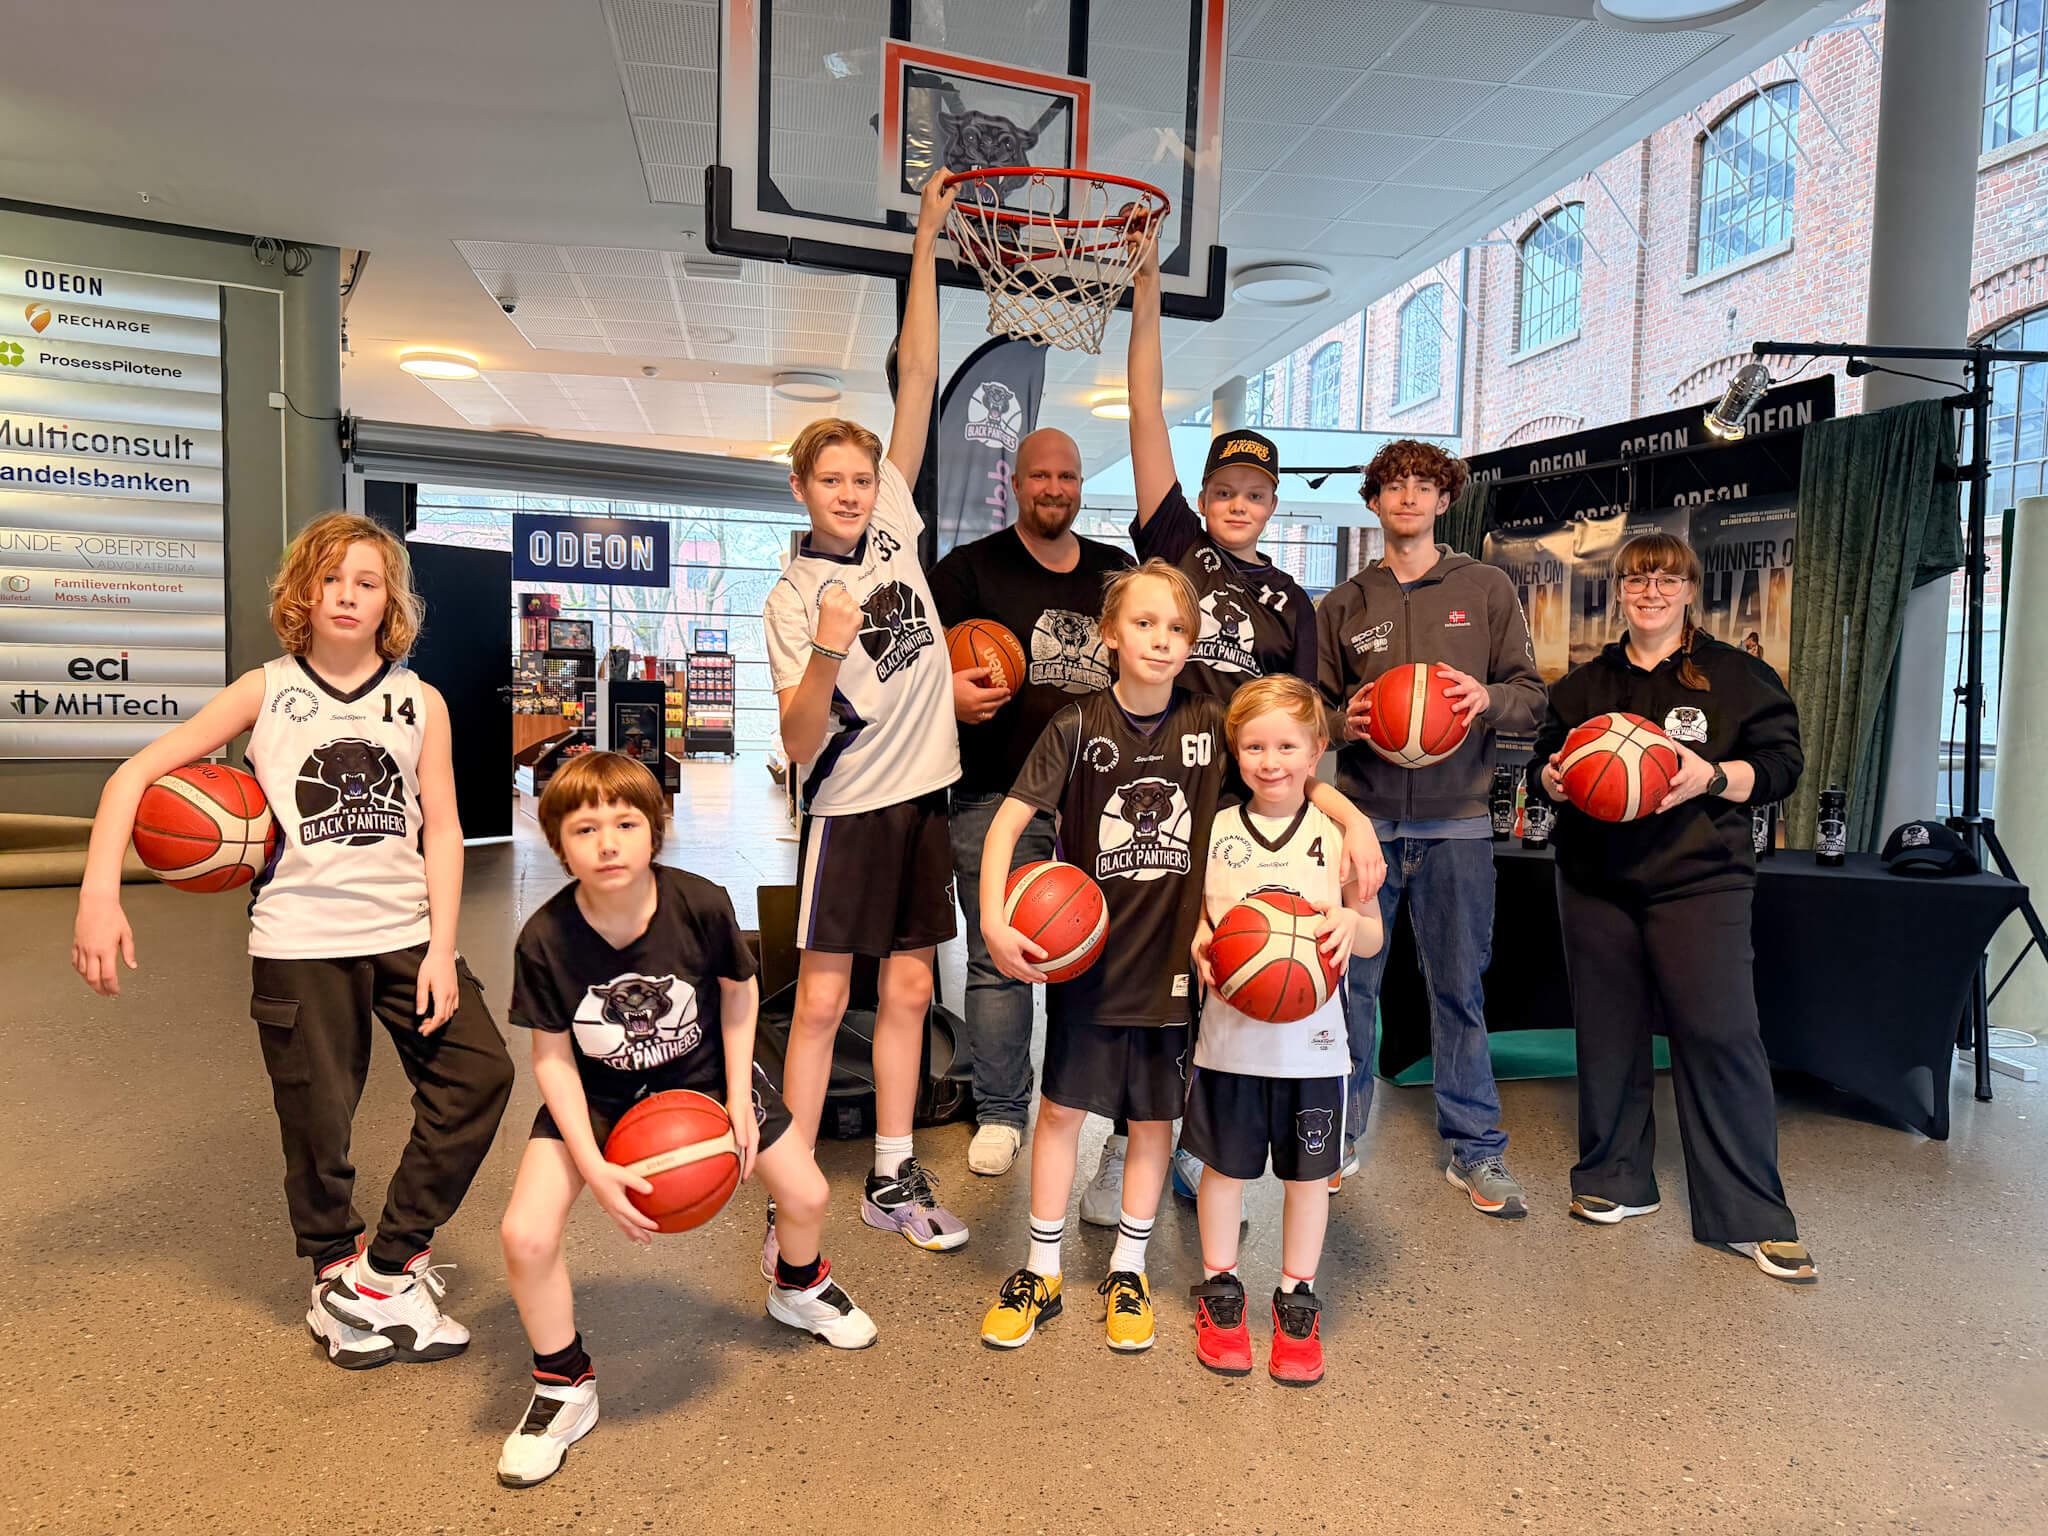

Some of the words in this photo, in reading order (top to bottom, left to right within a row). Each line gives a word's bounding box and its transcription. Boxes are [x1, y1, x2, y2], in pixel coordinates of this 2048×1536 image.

[25, 269, 102, 296] ODEON
[58, 314, 151, 334] RECHARGE
[40, 352, 183, 378] ProsessPilotene
[1747, 400, 1813, 436] DEON
[1219, 440, 1271, 462] LAKERS
[0, 465, 191, 494] andelsbanken
[0, 533, 62, 552] UNDE
[66, 536, 196, 569] ROBERTSEN
[529, 530, 654, 572] ODEON
[873, 529, 901, 562] 33
[1705, 539, 1777, 572] MINNER
[1781, 537, 1795, 568] O
[97, 559, 195, 573] ADVOKATFIRMA
[54, 577, 184, 593] Familievernkontoret
[55, 592, 87, 603] Moss
[91, 592, 131, 605] Askim
[68, 651, 129, 682] eci
[878, 647, 903, 680] BLACK
[1033, 663, 1064, 681] BLACK
[54, 693, 179, 717] MHTech
[382, 693, 417, 726] 14
[1181, 732, 1212, 767] 60
[303, 815, 345, 842] BLACK
[346, 813, 406, 834] PANTHERS
[1100, 851, 1134, 873] BLACK
[1136, 849, 1189, 871] PANTHERS
[1306, 836, 1325, 867] 4
[632, 1029, 698, 1071] PANTHERS
